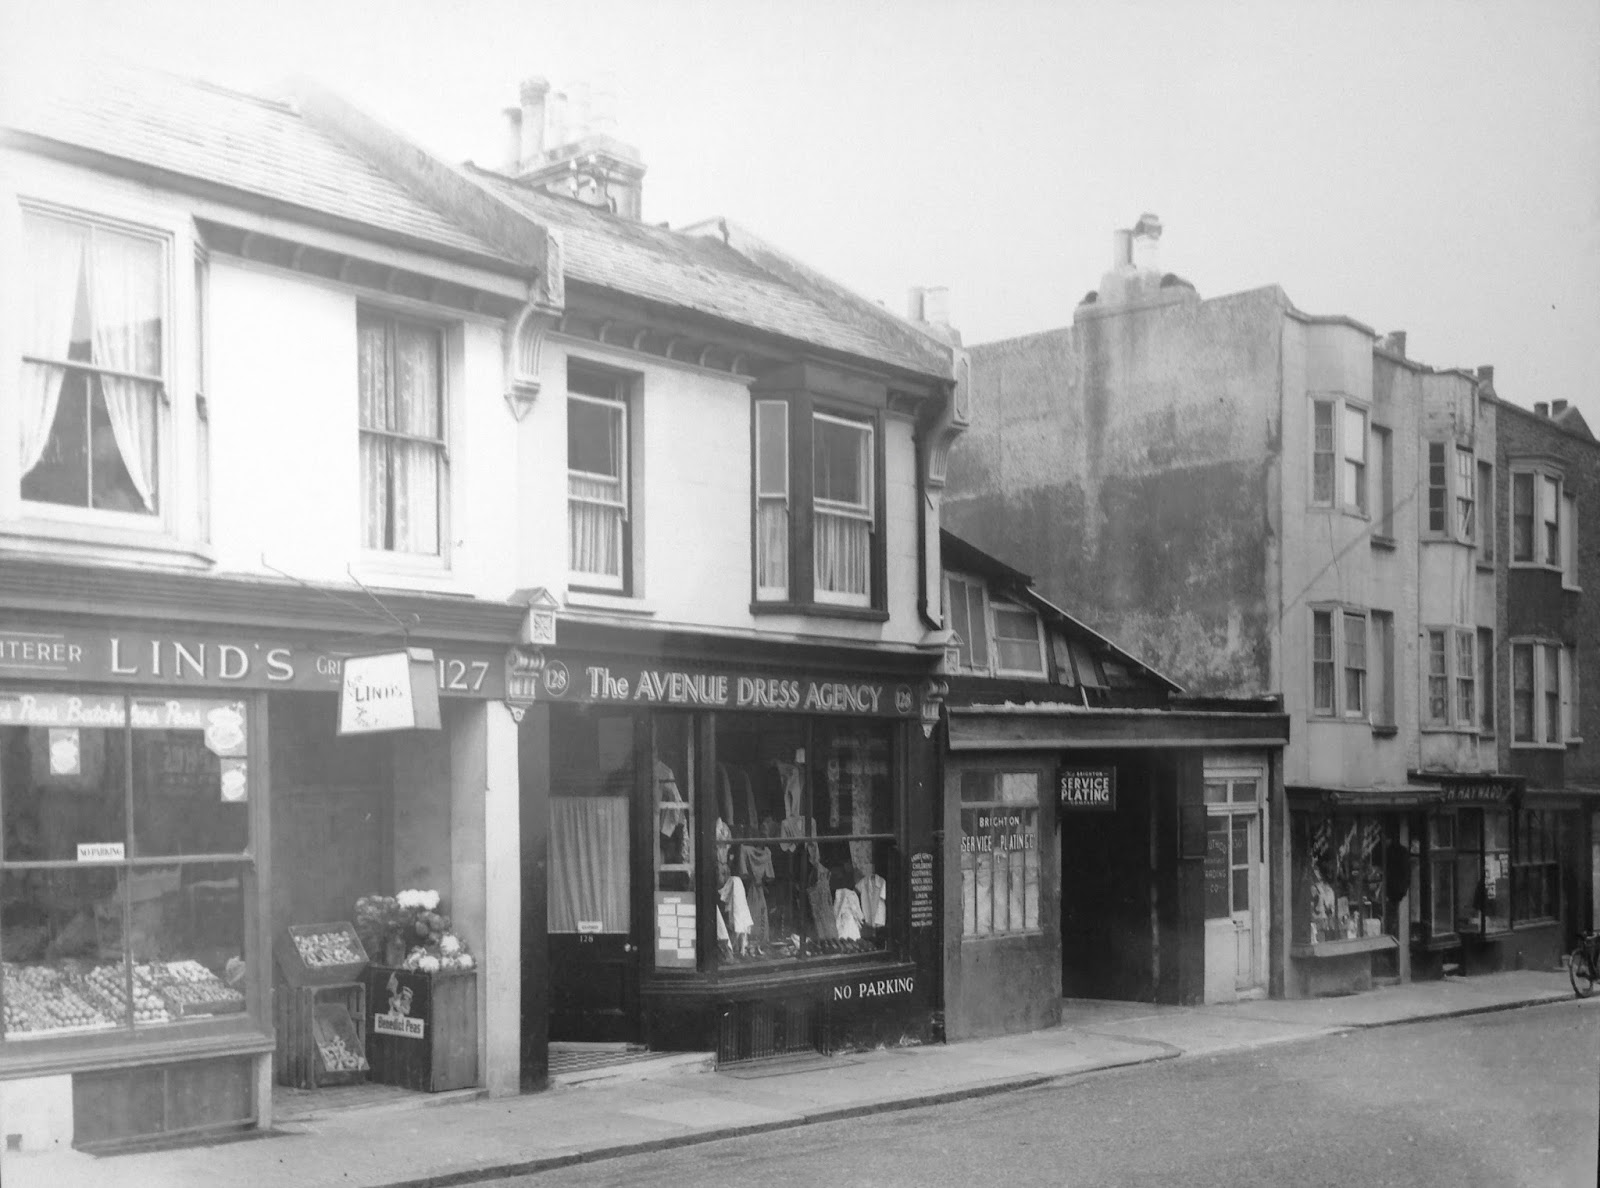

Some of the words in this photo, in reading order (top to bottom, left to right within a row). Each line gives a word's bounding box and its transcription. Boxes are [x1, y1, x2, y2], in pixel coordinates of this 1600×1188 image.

[109, 638, 294, 681] LIND'S
[439, 658, 489, 690] 127
[546, 669, 567, 689] 128
[586, 666, 629, 699] The
[633, 670, 728, 704] AVENUE
[736, 677, 800, 708] DRESS
[803, 682, 882, 713] AGENCY
[1061, 777, 1109, 789] SERVICE
[1061, 788, 1109, 801] PLATING
[979, 816, 1020, 828] BRIGHTON
[961, 835, 992, 852] SERVICE
[834, 985, 852, 1001] NO
[859, 977, 914, 998] PARKING
